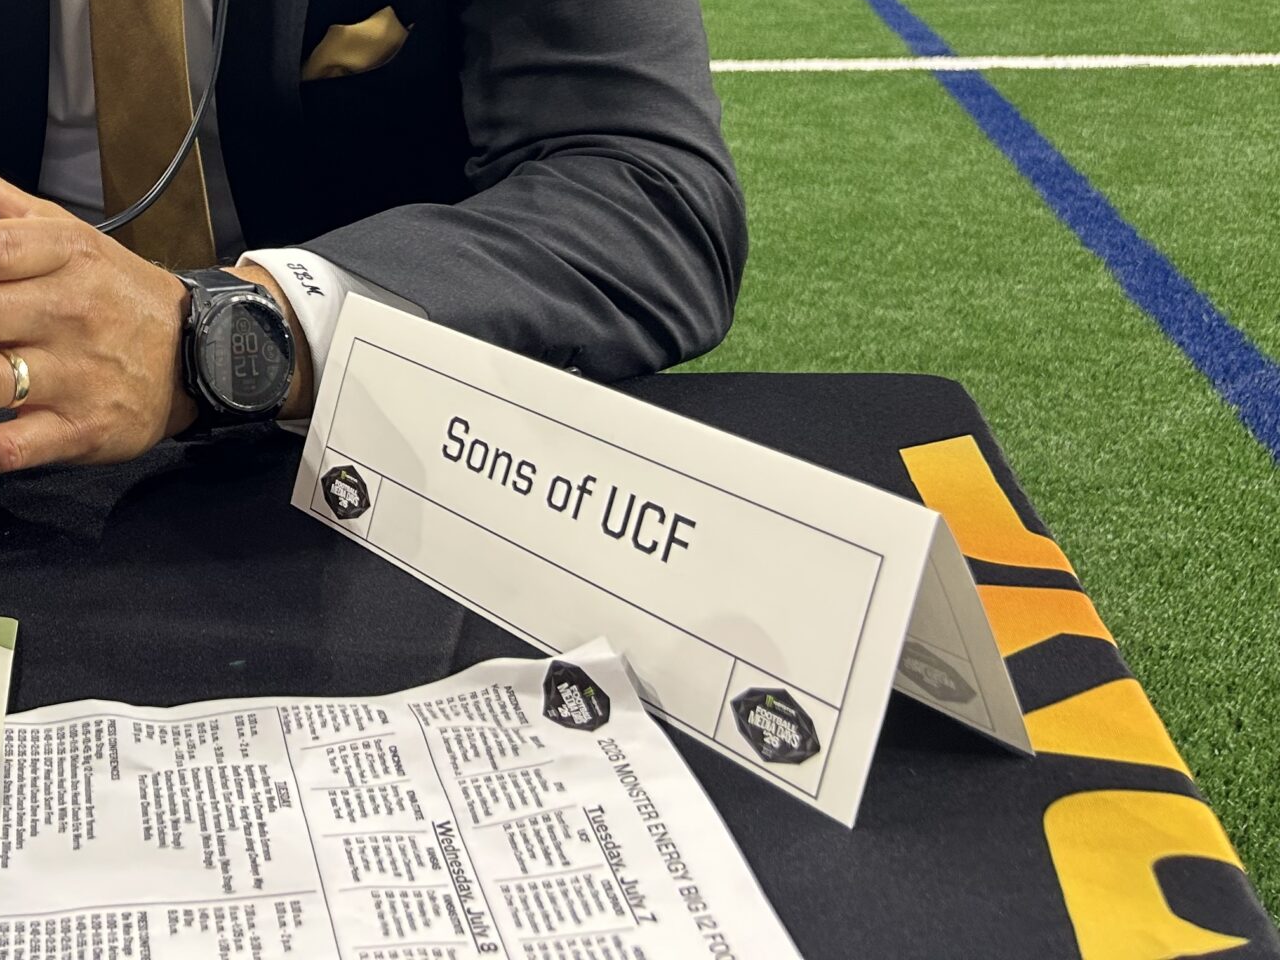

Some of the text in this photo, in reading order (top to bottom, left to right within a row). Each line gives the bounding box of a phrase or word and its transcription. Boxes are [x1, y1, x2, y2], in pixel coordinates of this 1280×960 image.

[440, 416, 697, 564] Sons of UCF
[557, 682, 579, 711] MEDIA
[755, 705, 798, 732] FOOTBALL
[107, 719, 120, 781] PRESS CONFERENCES
[748, 710, 800, 749] MEDIA DAYS
[277, 781, 291, 808] TUESDAY
[587, 805, 657, 923] Tuesday, July 7
[597, 739, 625, 762] 2026
[613, 764, 659, 821] MONSTER
[646, 824, 693, 881] ENERGY
[679, 885, 707, 912] BIG
[693, 915, 717, 930] 12
[436, 821, 498, 952] Wednesday, July 8
